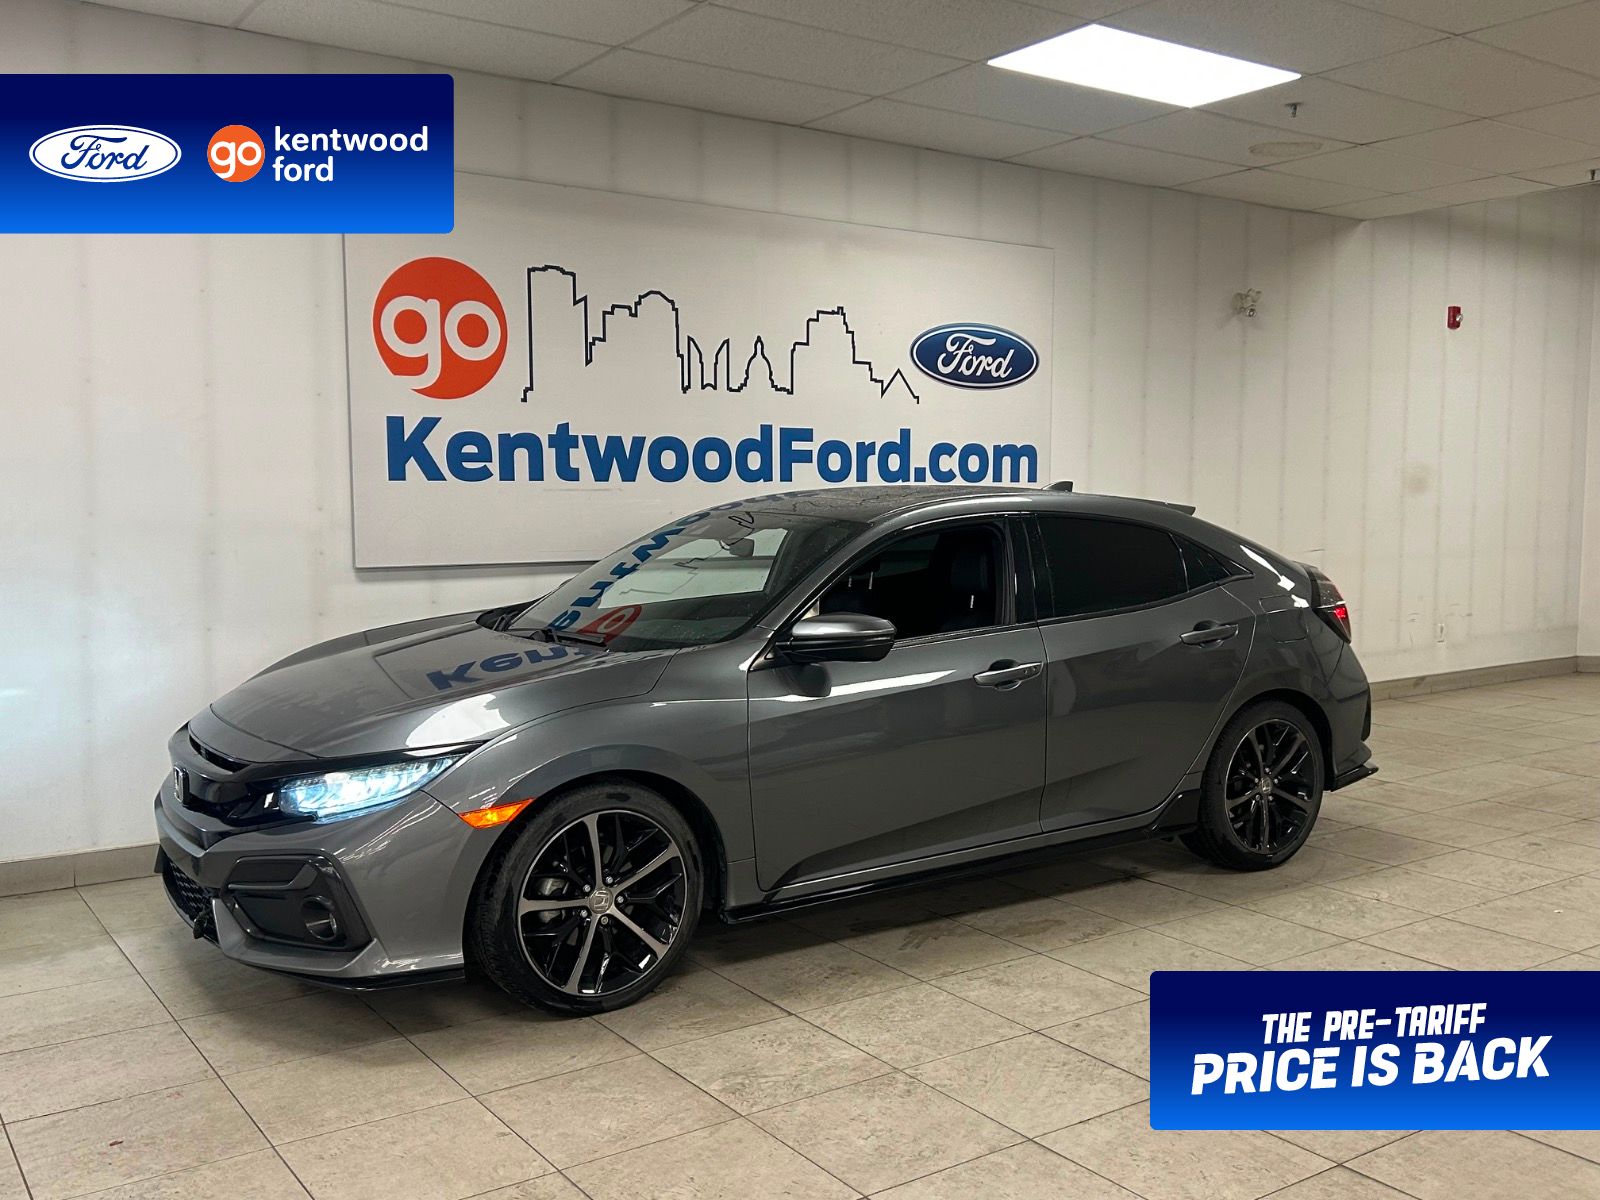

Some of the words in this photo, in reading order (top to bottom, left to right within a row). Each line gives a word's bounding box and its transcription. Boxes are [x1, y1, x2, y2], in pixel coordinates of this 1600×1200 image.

[380, 295, 502, 391] go
[937, 332, 1015, 379] Ford
[386, 415, 1038, 483] KentwoodFord.com
